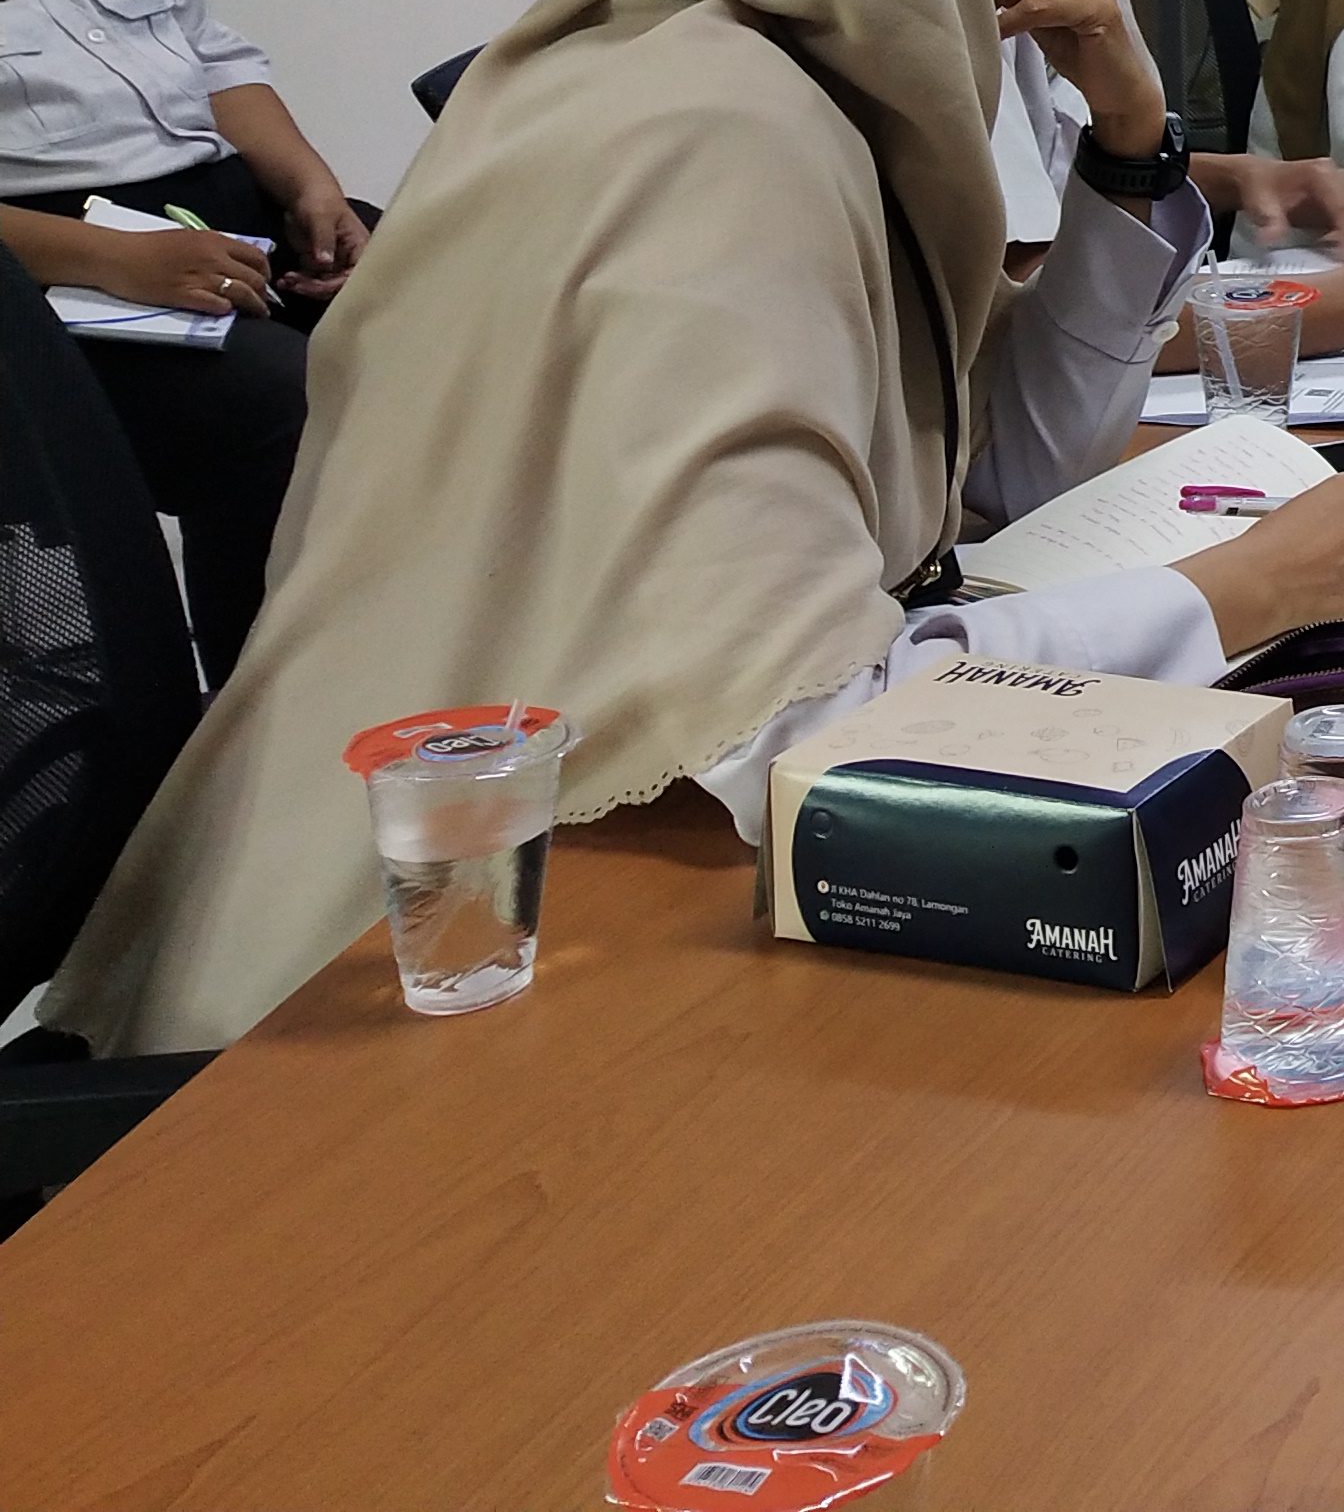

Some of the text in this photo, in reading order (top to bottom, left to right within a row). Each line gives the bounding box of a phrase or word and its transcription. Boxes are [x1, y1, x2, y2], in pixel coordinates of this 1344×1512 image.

[933, 661, 1101, 696] AMANAH
[1177, 819, 1242, 906] AMANAH
[831, 899, 911, 922] Toko Amanah Jaya
[839, 885, 857, 896] KHA
[860, 890, 890, 902] Dahlan
[922, 900, 968, 915] Lamongan
[832, 912, 900, 931] 0858 5211 2699
[1026, 919, 1118, 960] AMANAH
[1042, 946, 1103, 963] CATERING
[747, 1388, 852, 1433] Cleo
